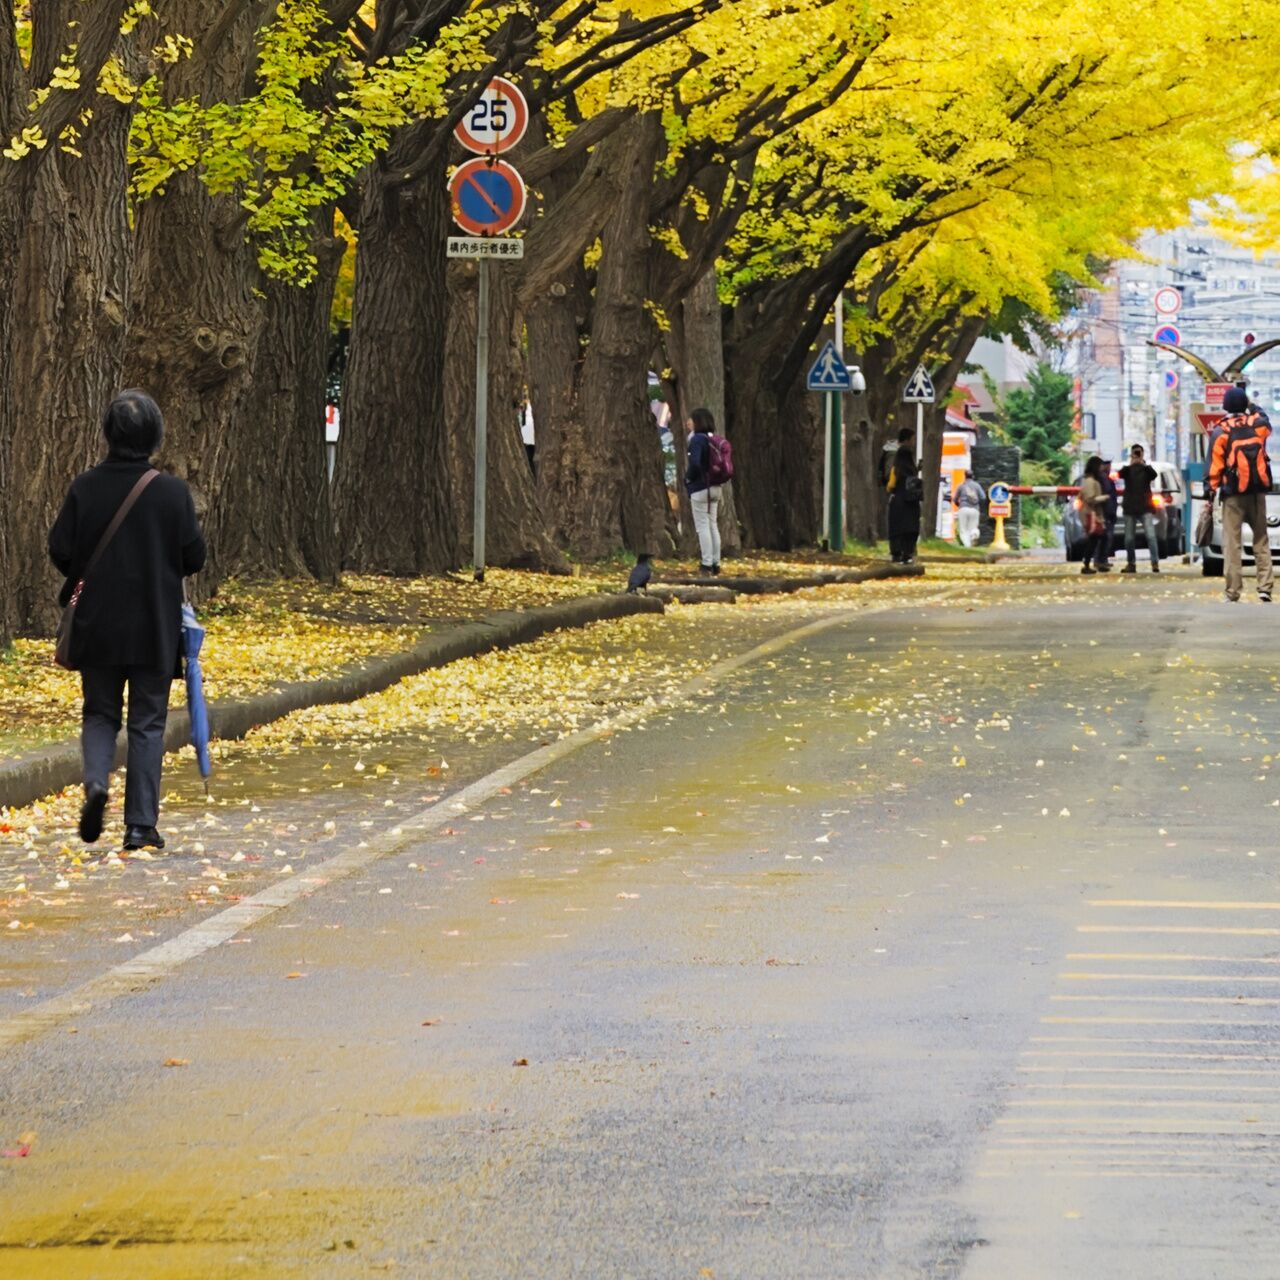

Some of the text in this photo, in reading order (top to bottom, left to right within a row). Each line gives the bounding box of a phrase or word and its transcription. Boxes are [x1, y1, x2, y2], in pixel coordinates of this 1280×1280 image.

[471, 100, 508, 131] 25
[450, 242, 519, 255] 構内歩行者優先
[1160, 295, 1175, 307] 50
